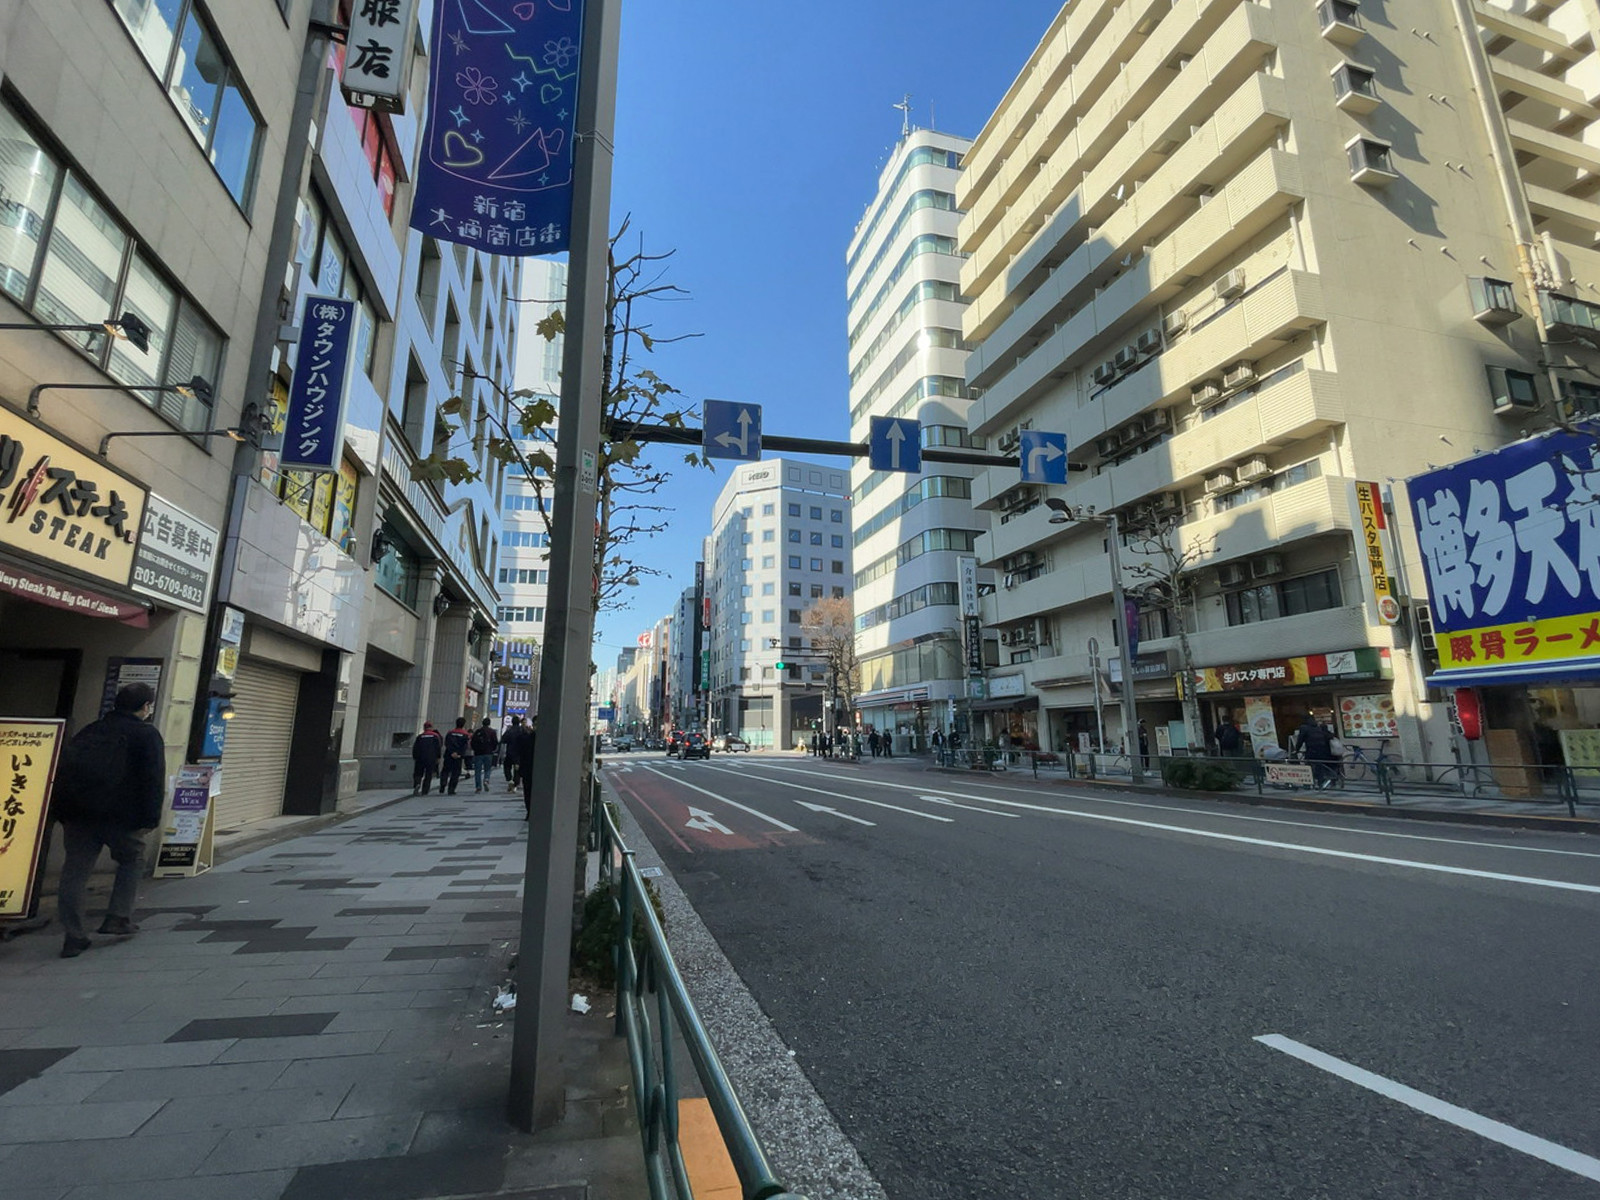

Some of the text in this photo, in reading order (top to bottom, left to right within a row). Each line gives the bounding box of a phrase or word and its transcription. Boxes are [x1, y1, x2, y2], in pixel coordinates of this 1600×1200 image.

[349, 0, 400, 78] 服店
[429, 208, 562, 247] 大通商店街
[474, 195, 526, 221] 新宿
[40, 467, 128, 538] ステーキ
[29, 509, 112, 560] STEAK
[143, 506, 213, 562] 広告募集中
[46, 585, 61, 600] The
[62, 590, 77, 607] Big
[76, 595, 91, 608] Cut
[97, 602, 119, 616] Steak
[143, 568, 202, 603] 03-6709-8823
[1223, 666, 1286, 684] 生パスタ専門店
[3, 754, 33, 839] いきなり
